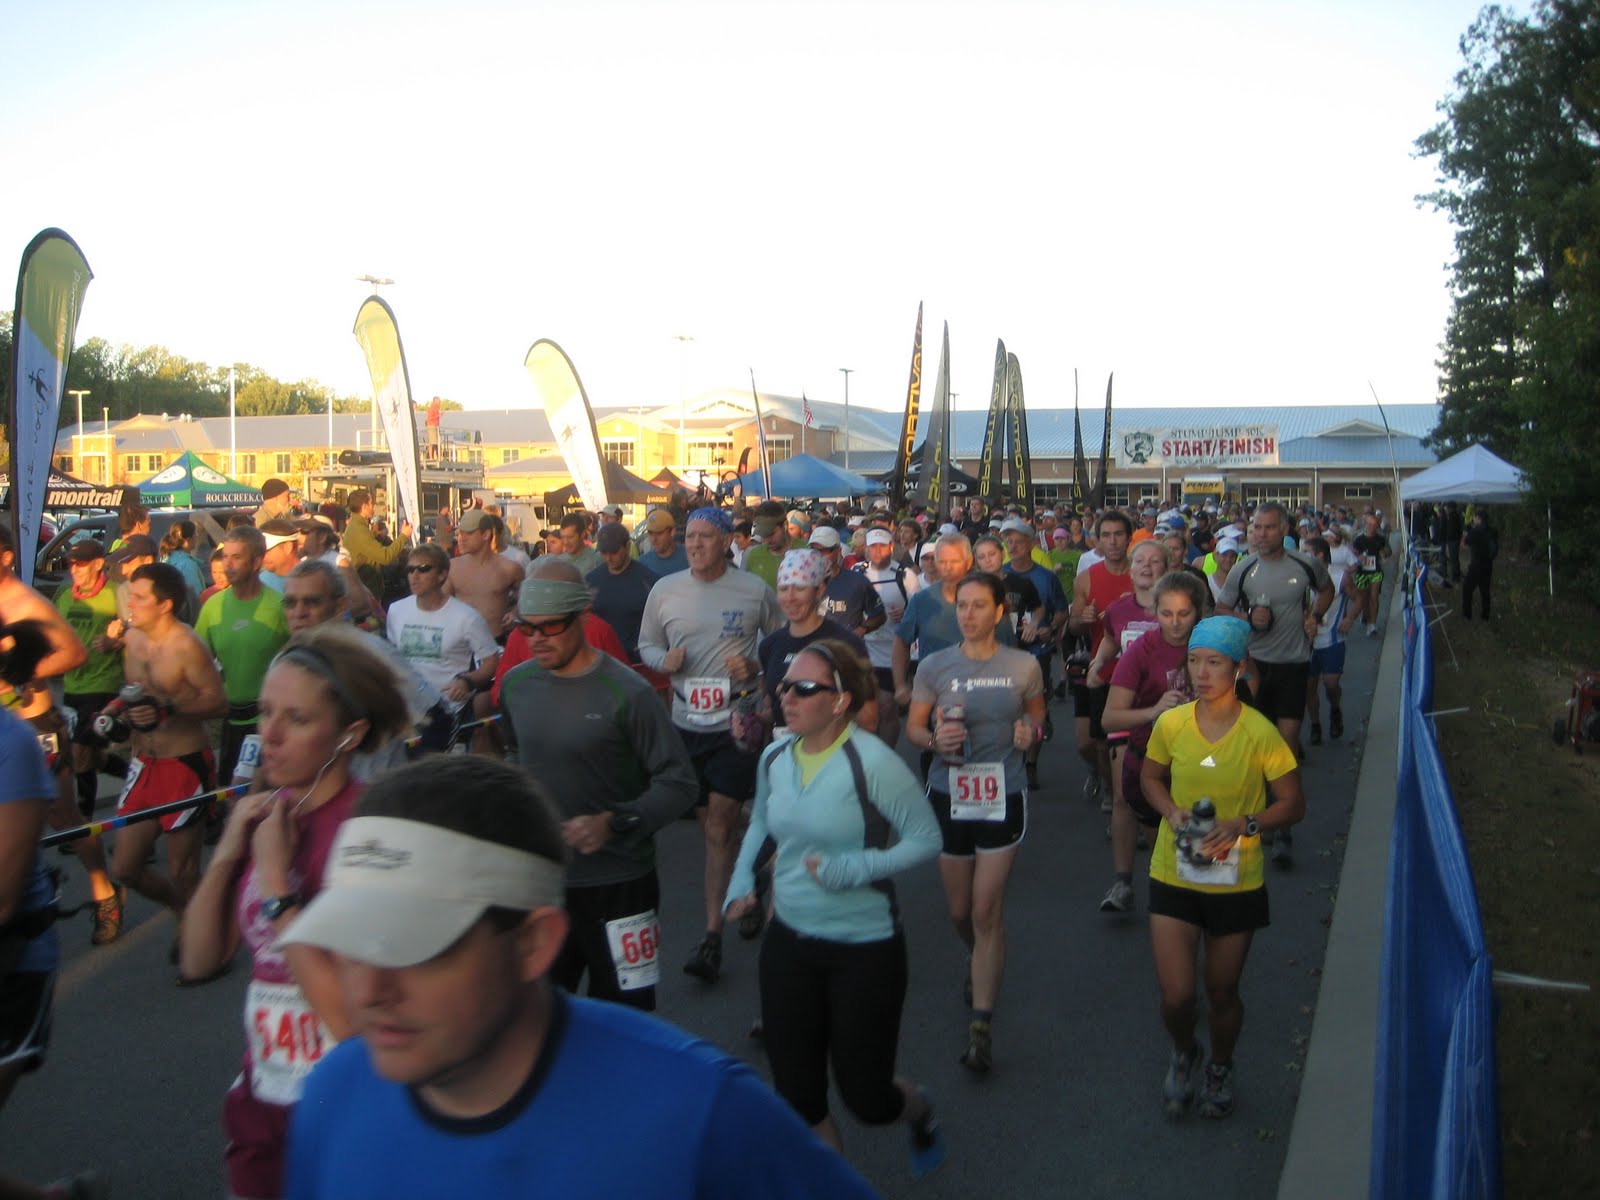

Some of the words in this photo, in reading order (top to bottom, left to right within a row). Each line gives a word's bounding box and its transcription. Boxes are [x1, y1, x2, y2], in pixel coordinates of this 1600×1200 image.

[1162, 438, 1275, 457] START/FINISH
[48, 489, 124, 507] montrail
[689, 687, 724, 711] 459
[957, 775, 998, 801] 519
[255, 1008, 324, 1063] 540
